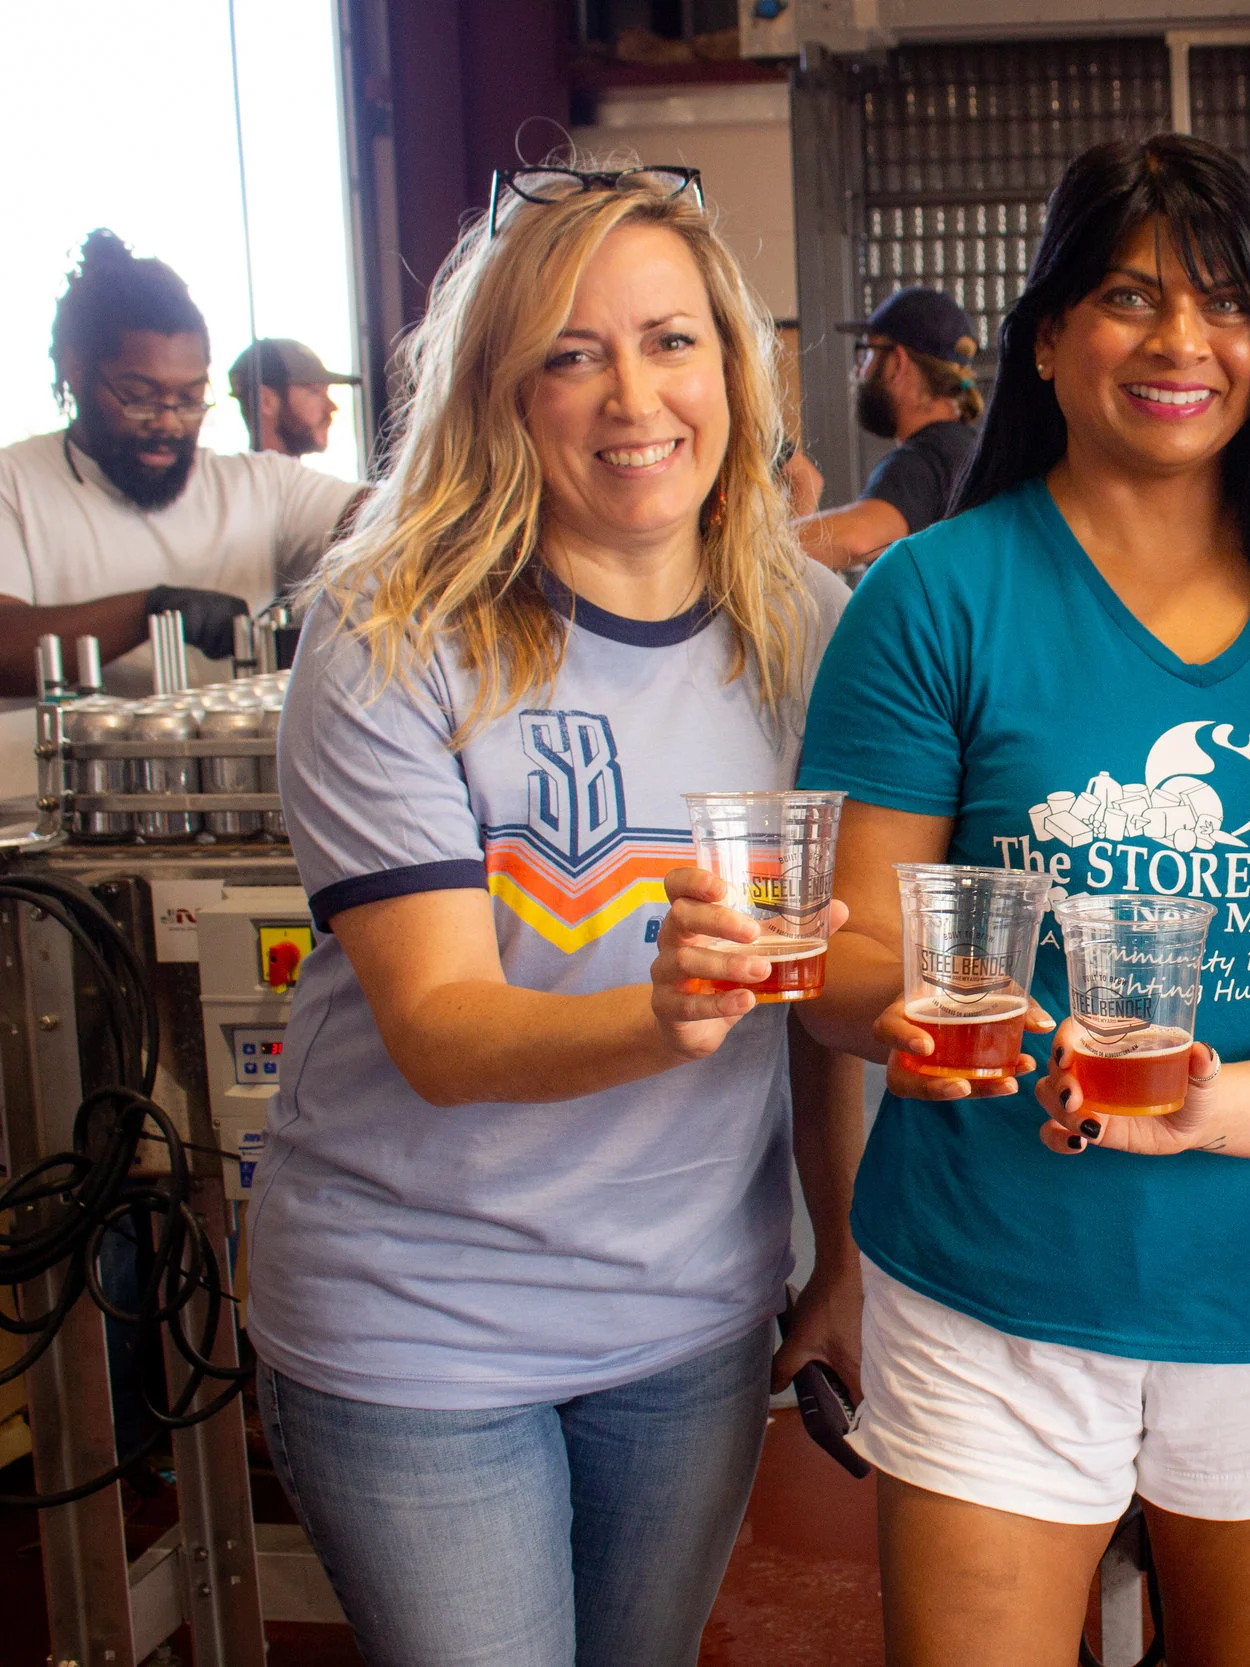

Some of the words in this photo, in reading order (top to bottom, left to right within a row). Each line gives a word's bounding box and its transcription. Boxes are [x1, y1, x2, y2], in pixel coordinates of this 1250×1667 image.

[993, 836, 1071, 884] The
[753, 876, 796, 898] STEEL
[922, 949, 959, 975] STEEL
[962, 954, 1012, 977] BENDER
[1099, 997, 1152, 1019] BENDER
